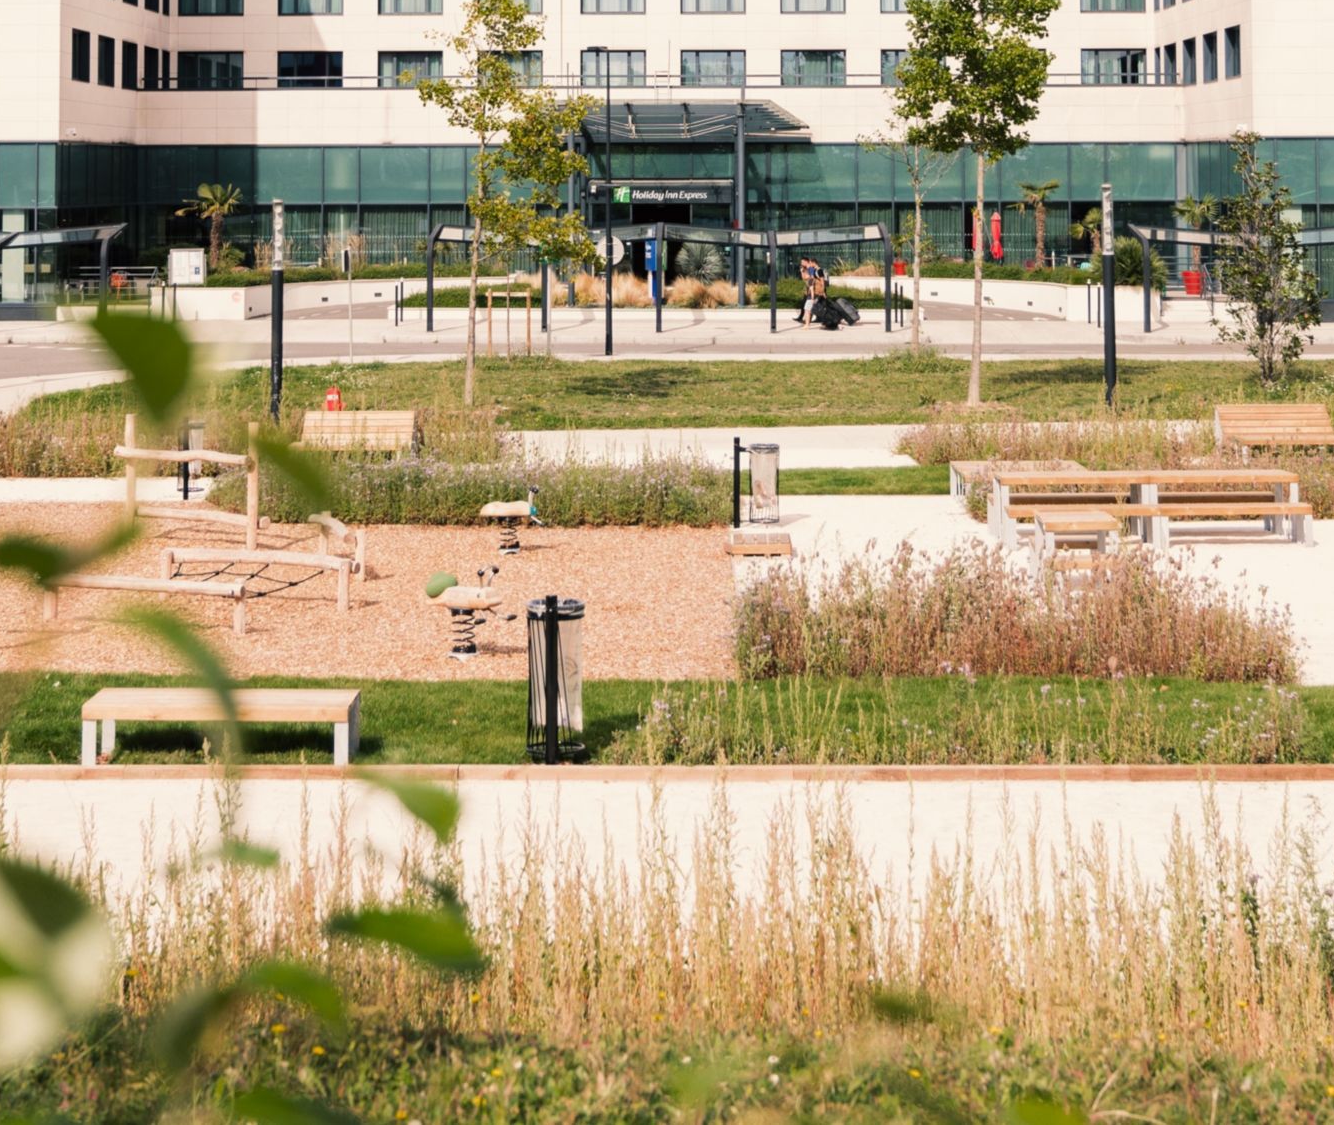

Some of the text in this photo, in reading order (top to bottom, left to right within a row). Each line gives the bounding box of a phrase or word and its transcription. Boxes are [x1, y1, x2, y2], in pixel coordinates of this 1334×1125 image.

[632, 190, 664, 201] Holiday
[665, 190, 678, 199] Inn
[679, 190, 707, 201] Express
